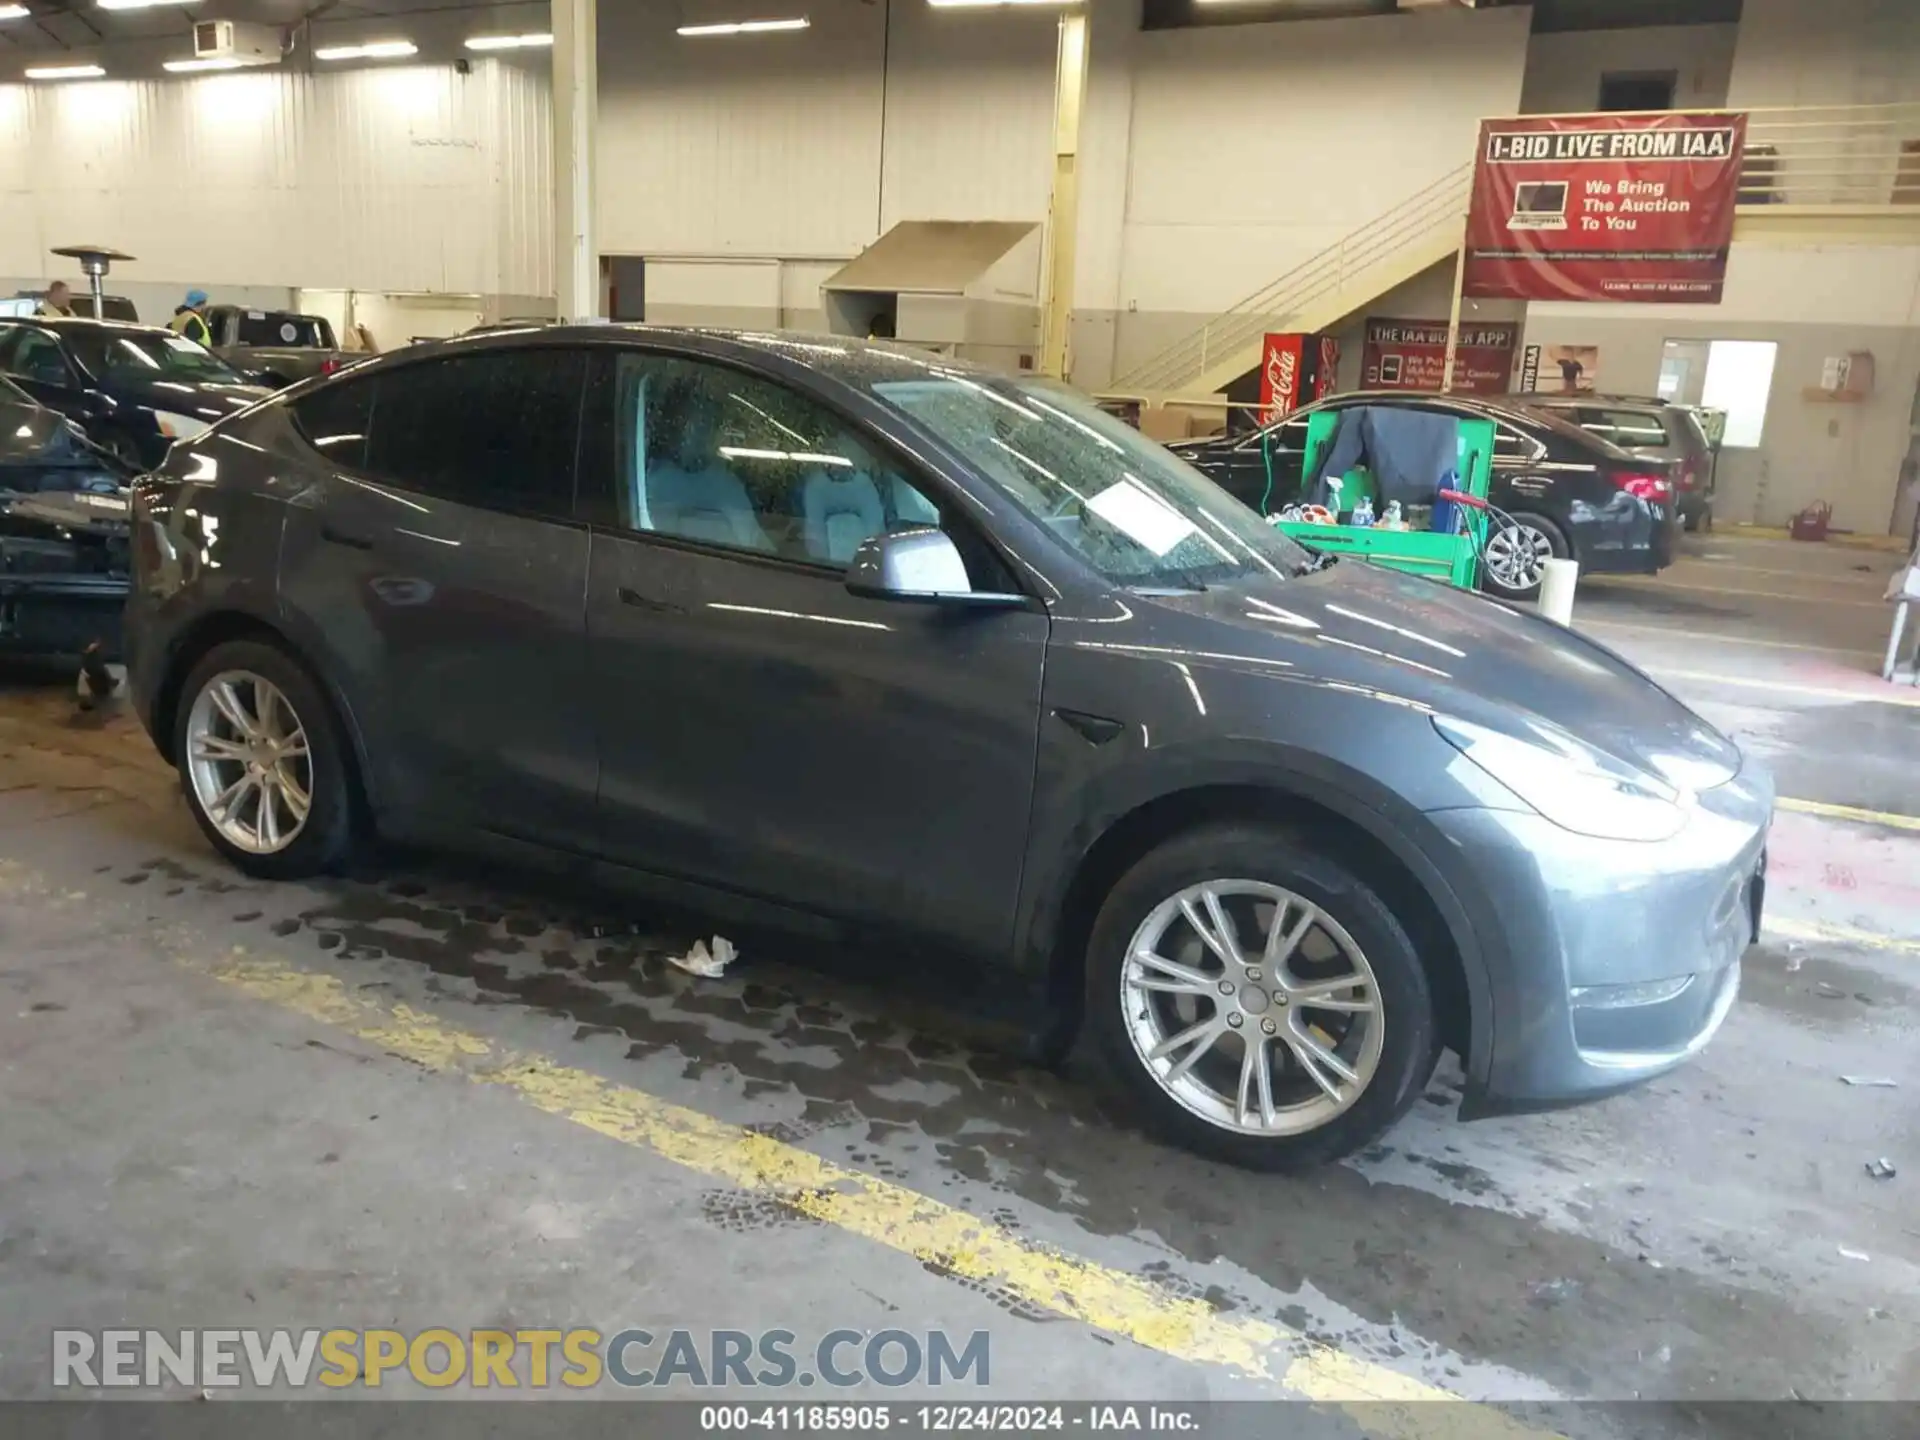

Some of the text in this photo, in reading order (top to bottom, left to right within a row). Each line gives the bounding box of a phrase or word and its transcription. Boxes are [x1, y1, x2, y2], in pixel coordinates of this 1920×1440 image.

[1494, 131, 1725, 159] I-BID LIVE FROM IAA
[1585, 179, 1665, 197] We Bring
[1583, 197, 1691, 213] The Auction
[1580, 215, 1637, 231] To You
[1375, 327, 1399, 341] THE
[1401, 329, 1426, 343] IAA
[1476, 332, 1506, 345] APP
